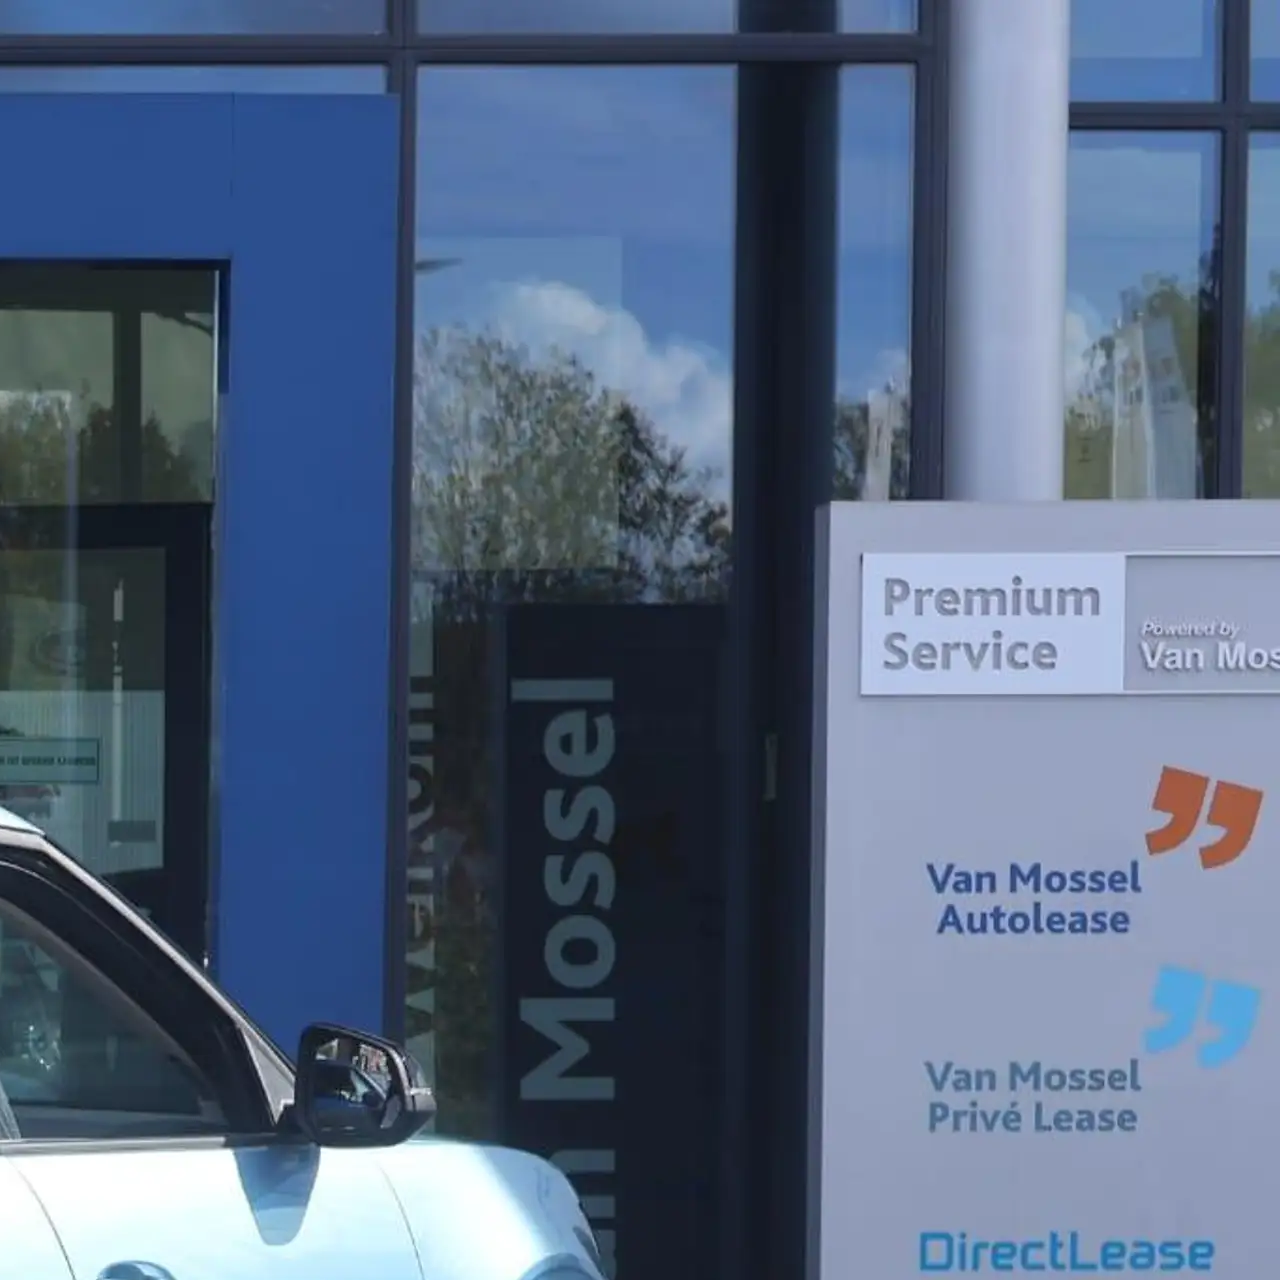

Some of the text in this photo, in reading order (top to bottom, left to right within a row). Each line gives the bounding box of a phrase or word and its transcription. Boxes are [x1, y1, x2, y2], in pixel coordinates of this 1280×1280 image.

[883, 575, 1101, 617] Premium
[1141, 620, 1241, 639] Powered by
[882, 629, 1059, 671] Service
[1141, 642, 1204, 669] Van
[511, 677, 616, 1102] Mossel
[926, 860, 1142, 894] Van Mossel
[936, 901, 1130, 935] Autolease
[924, 1058, 1142, 1092] Van Mossel
[929, 1100, 1138, 1133] Privé Lease
[919, 1231, 1216, 1272] DirectLease
